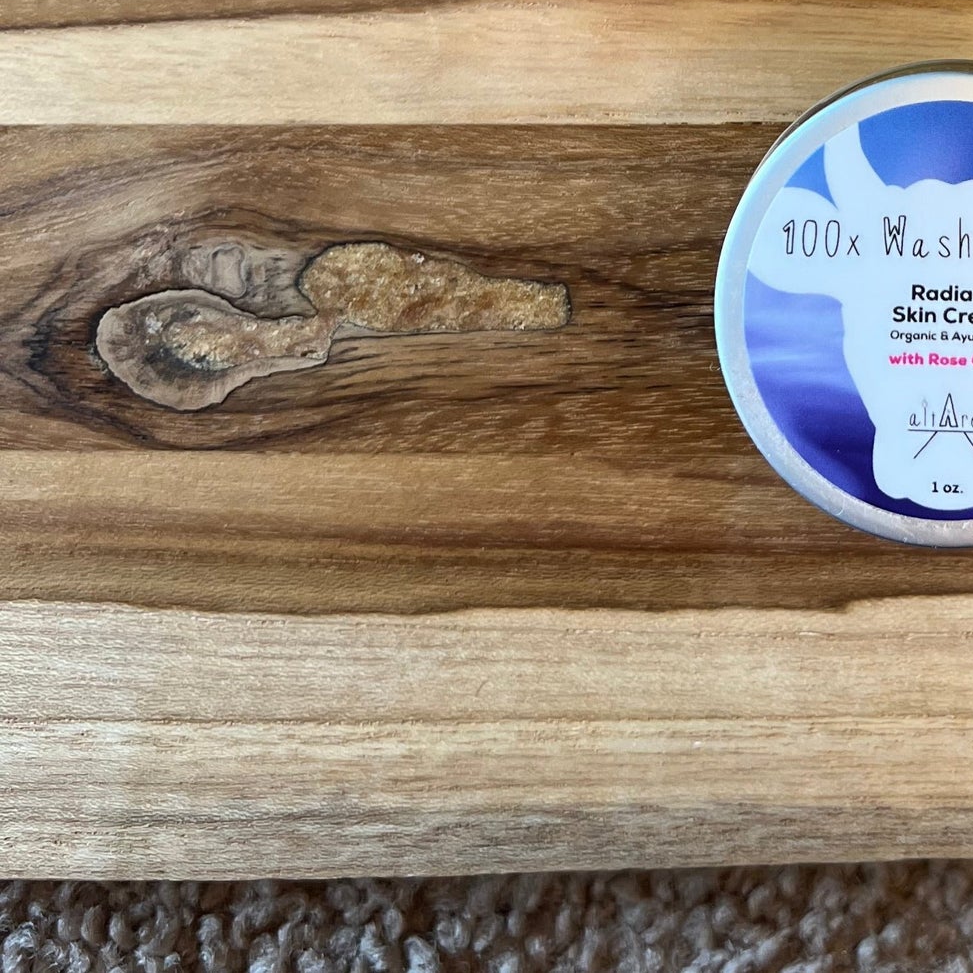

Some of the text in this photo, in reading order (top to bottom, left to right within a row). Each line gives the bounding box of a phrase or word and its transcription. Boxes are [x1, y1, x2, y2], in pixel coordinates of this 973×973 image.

[781, 218, 862, 259] 100x
[891, 305, 937, 324] Skin
[889, 329, 938, 344] Organic
[939, 330, 950, 342] &
[888, 351, 925, 366] with
[928, 352, 968, 367] Rose
[931, 480, 964, 494] 1 oz.
